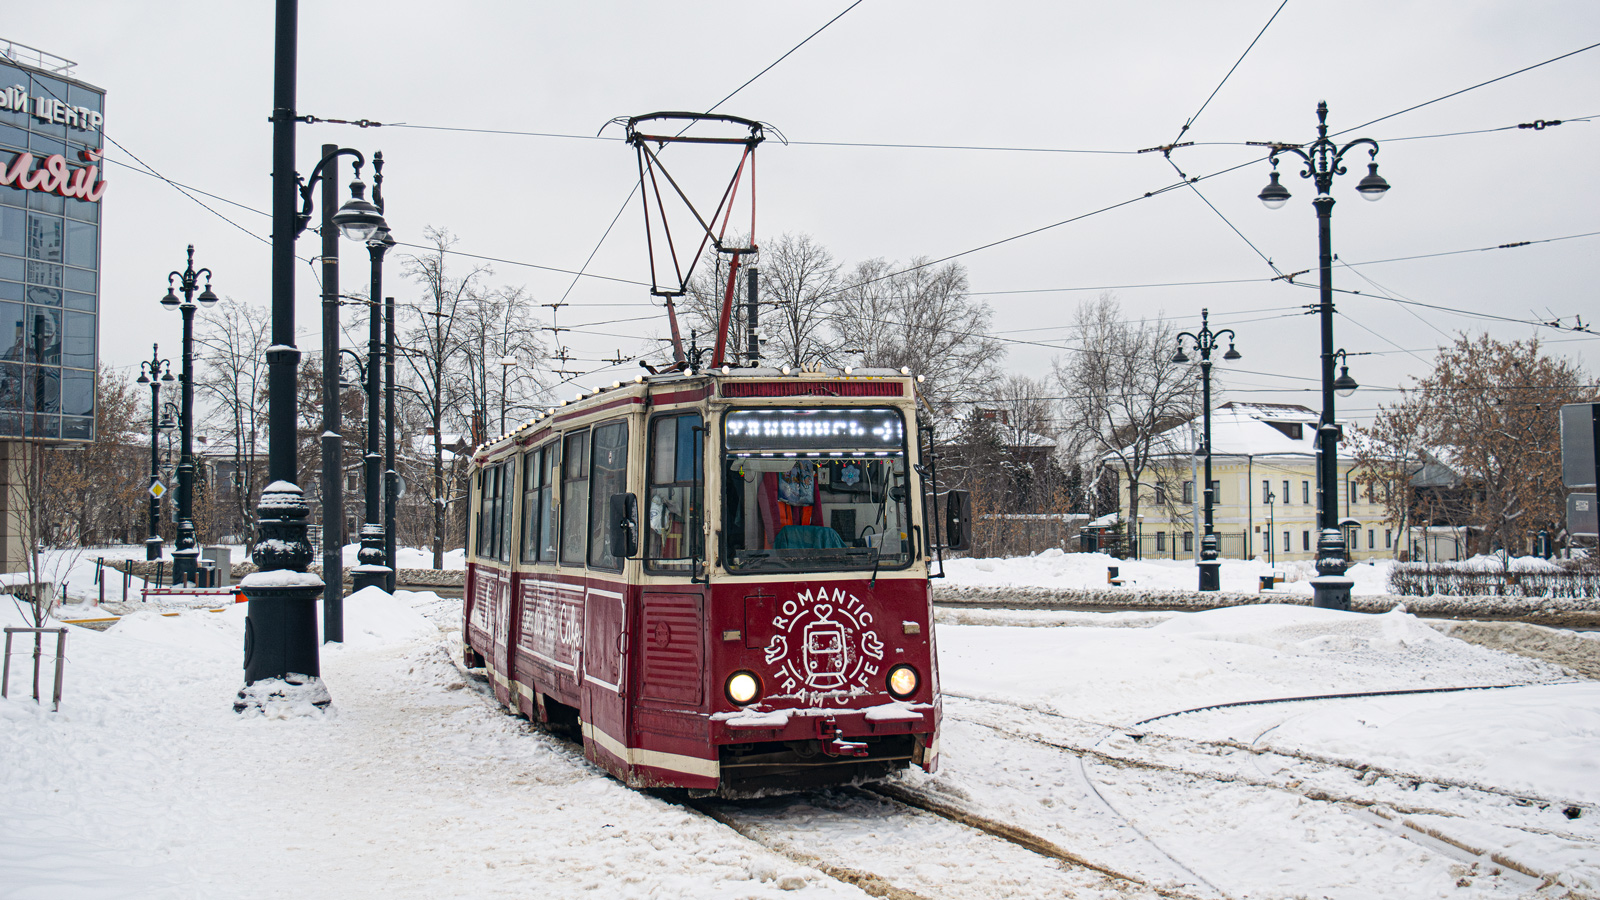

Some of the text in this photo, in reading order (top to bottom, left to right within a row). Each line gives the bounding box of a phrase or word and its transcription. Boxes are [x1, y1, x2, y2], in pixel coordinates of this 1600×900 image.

[35, 96, 103, 132] ЦЕНТР
[772, 586, 873, 630] ROMANTIC
[773, 664, 823, 708] TRAM
